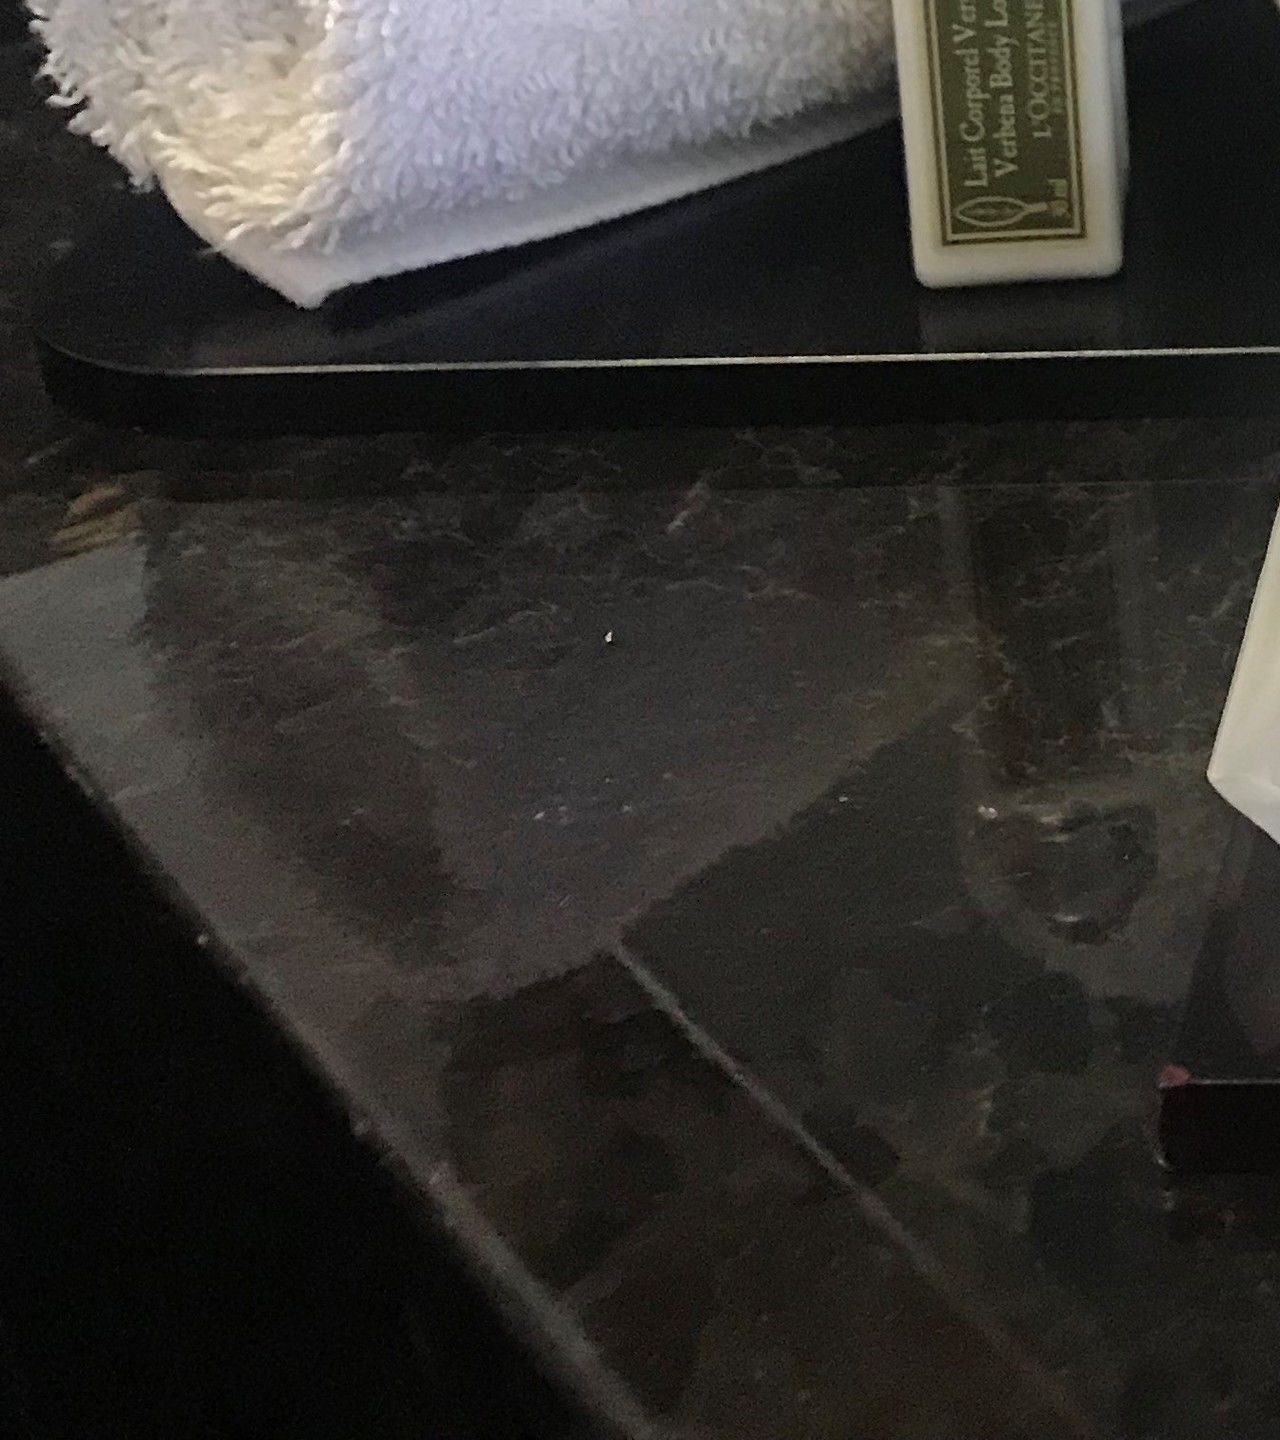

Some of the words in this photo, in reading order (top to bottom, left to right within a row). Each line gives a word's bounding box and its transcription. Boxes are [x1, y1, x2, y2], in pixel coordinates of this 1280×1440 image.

[987, 34, 1019, 87] Body
[954, 49, 989, 141] Corporel
[963, 147, 988, 187] Lait
[994, 95, 1018, 177] Verbena
